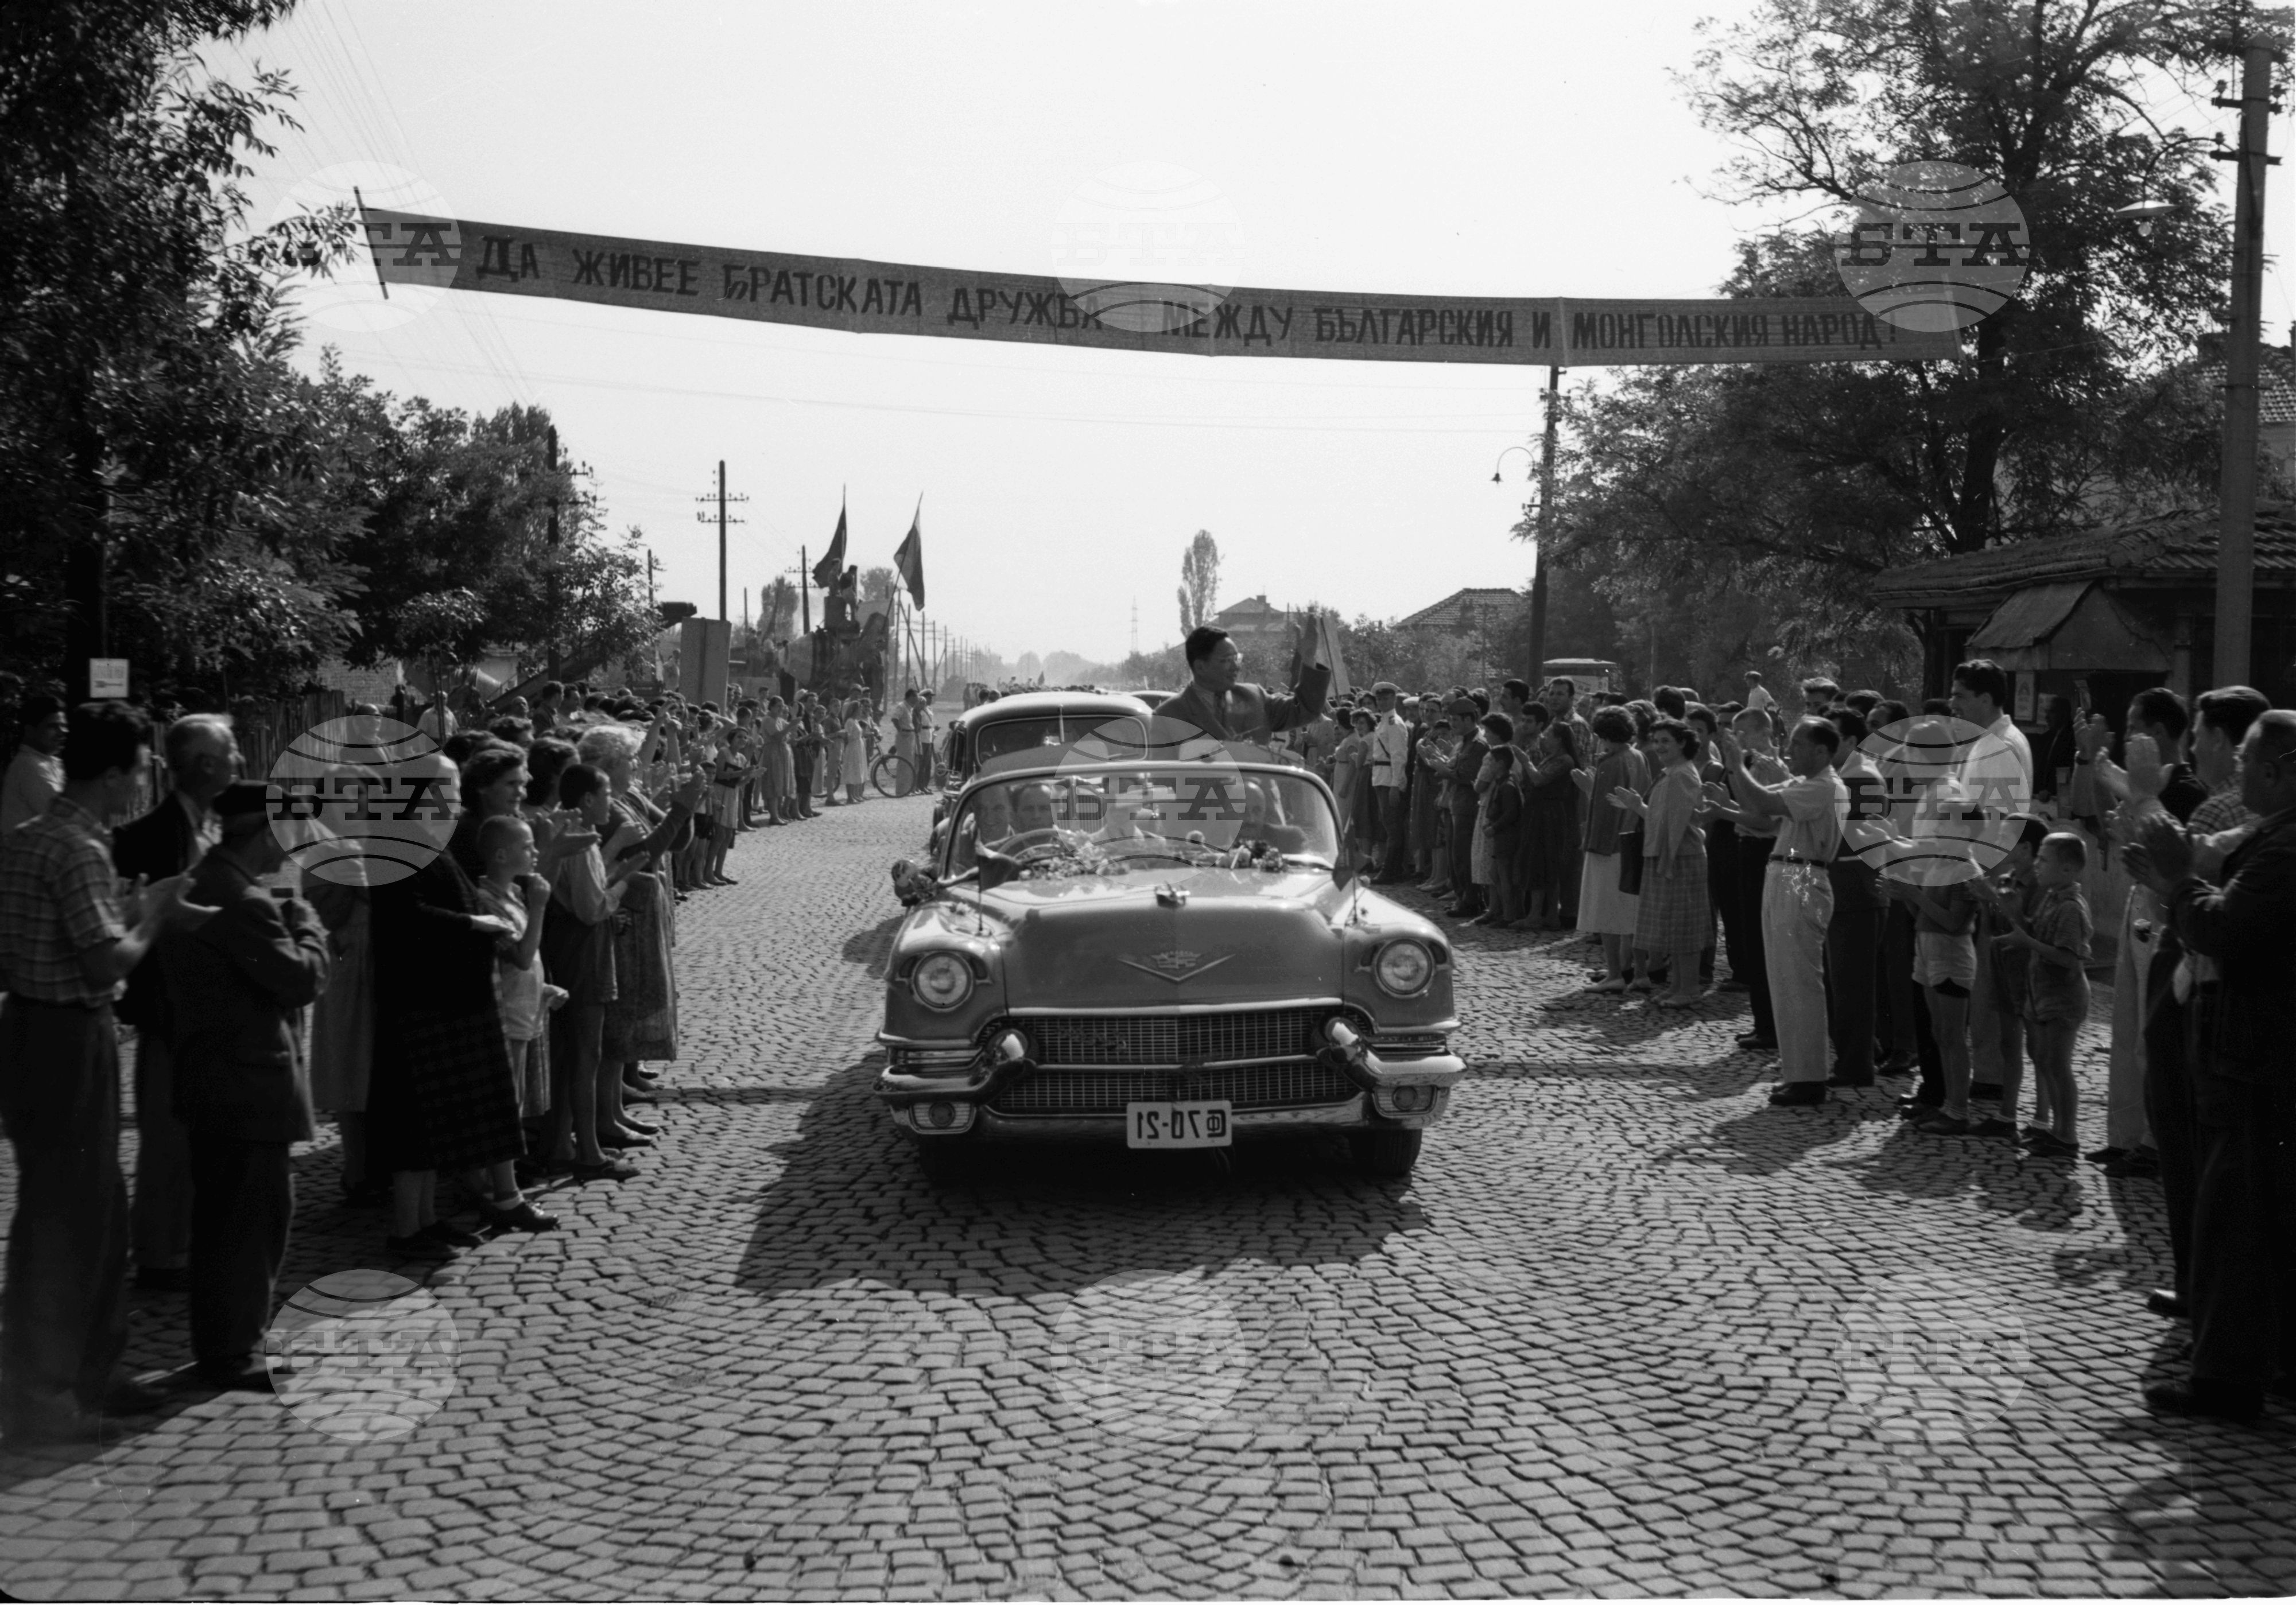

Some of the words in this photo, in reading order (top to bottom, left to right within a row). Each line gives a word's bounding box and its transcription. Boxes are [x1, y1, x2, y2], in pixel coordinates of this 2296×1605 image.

[476, 236, 540, 282] ДА
[573, 248, 700, 296] ЖИВЕЕ
[722, 264, 922, 316] БРАТСКАТА
[947, 288, 1103, 329] ДРУЖБА
[1161, 300, 1293, 346] МЕЖДУ
[1313, 308, 1513, 347] БЪЛГАРСКИЯ
[1532, 312, 1551, 348] И
[1573, 312, 1769, 349] МОНГОЛСКИЯ
